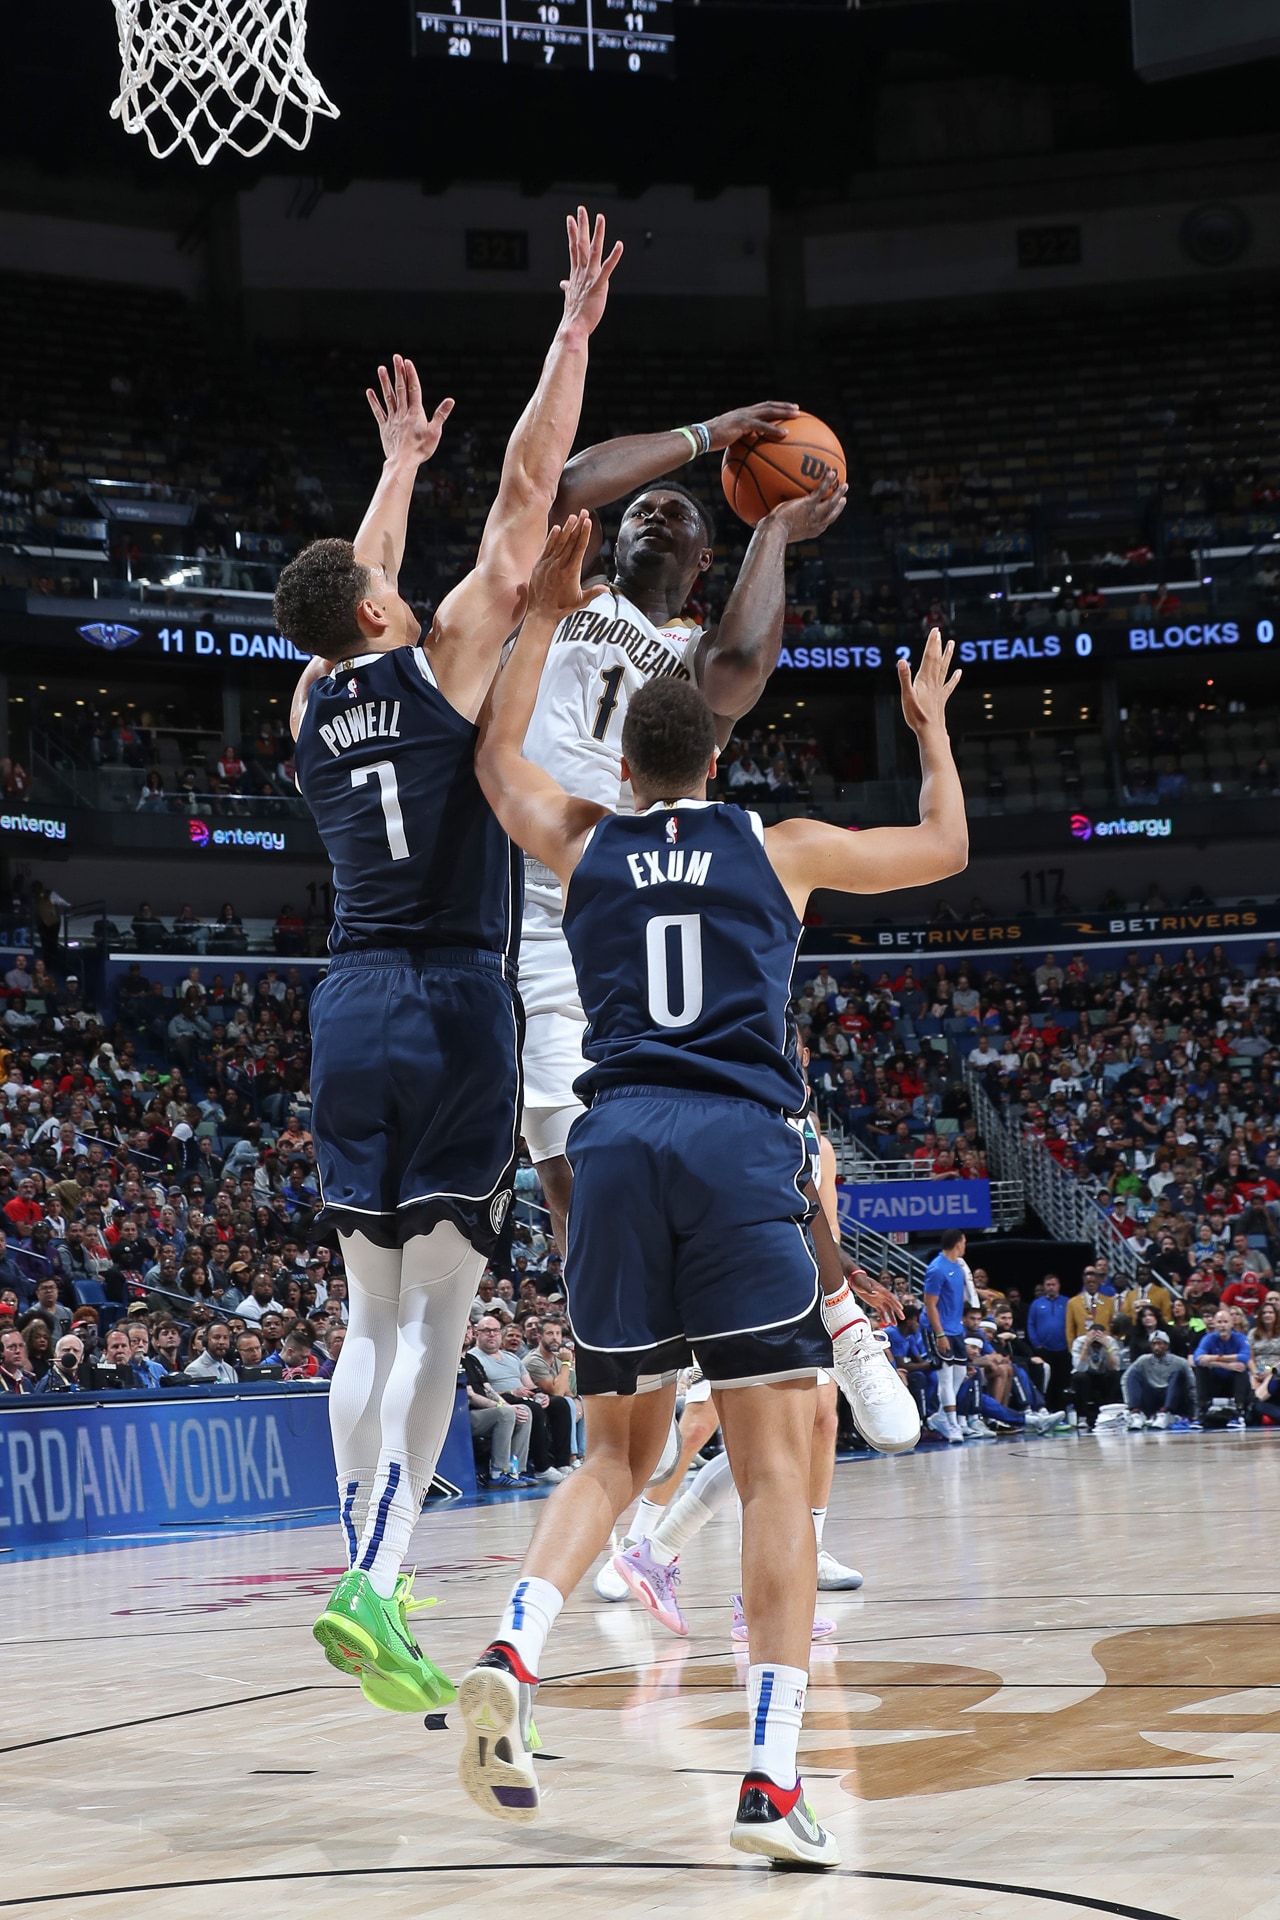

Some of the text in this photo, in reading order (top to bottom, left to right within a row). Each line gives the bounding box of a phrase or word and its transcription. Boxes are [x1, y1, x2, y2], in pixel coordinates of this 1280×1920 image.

[538, 5, 560, 24] 10
[624, 13, 643, 32] 11
[448, 37, 471, 57] 20
[543, 45, 555, 64] 7
[628, 53, 641, 72] 0
[61, 521, 91, 536] 320
[158, 628, 184, 652] 11
[195, 631, 222, 655] D.
[1129, 619, 1274, 650] BLOCKS 0
[777, 647, 882, 668] ASSISTS
[960, 633, 1092, 662] STEALS 0
[591, 664, 625, 742] 1
[318, 701, 401, 757] POWELL
[351, 760, 410, 861] 7
[0, 813, 66, 839] entergy
[1094, 818, 1172, 837] entergy
[212, 828, 285, 850] entergy
[626, 850, 713, 889] EXUM
[1020, 868, 1064, 905] 117
[878, 924, 1022, 946] BETRIVERS
[1109, 911, 1258, 934] BETRIVERS
[646, 913, 703, 1028] 0
[858, 1194, 978, 1219] FANDUEL
[150, 1414, 291, 1509] VODKA
